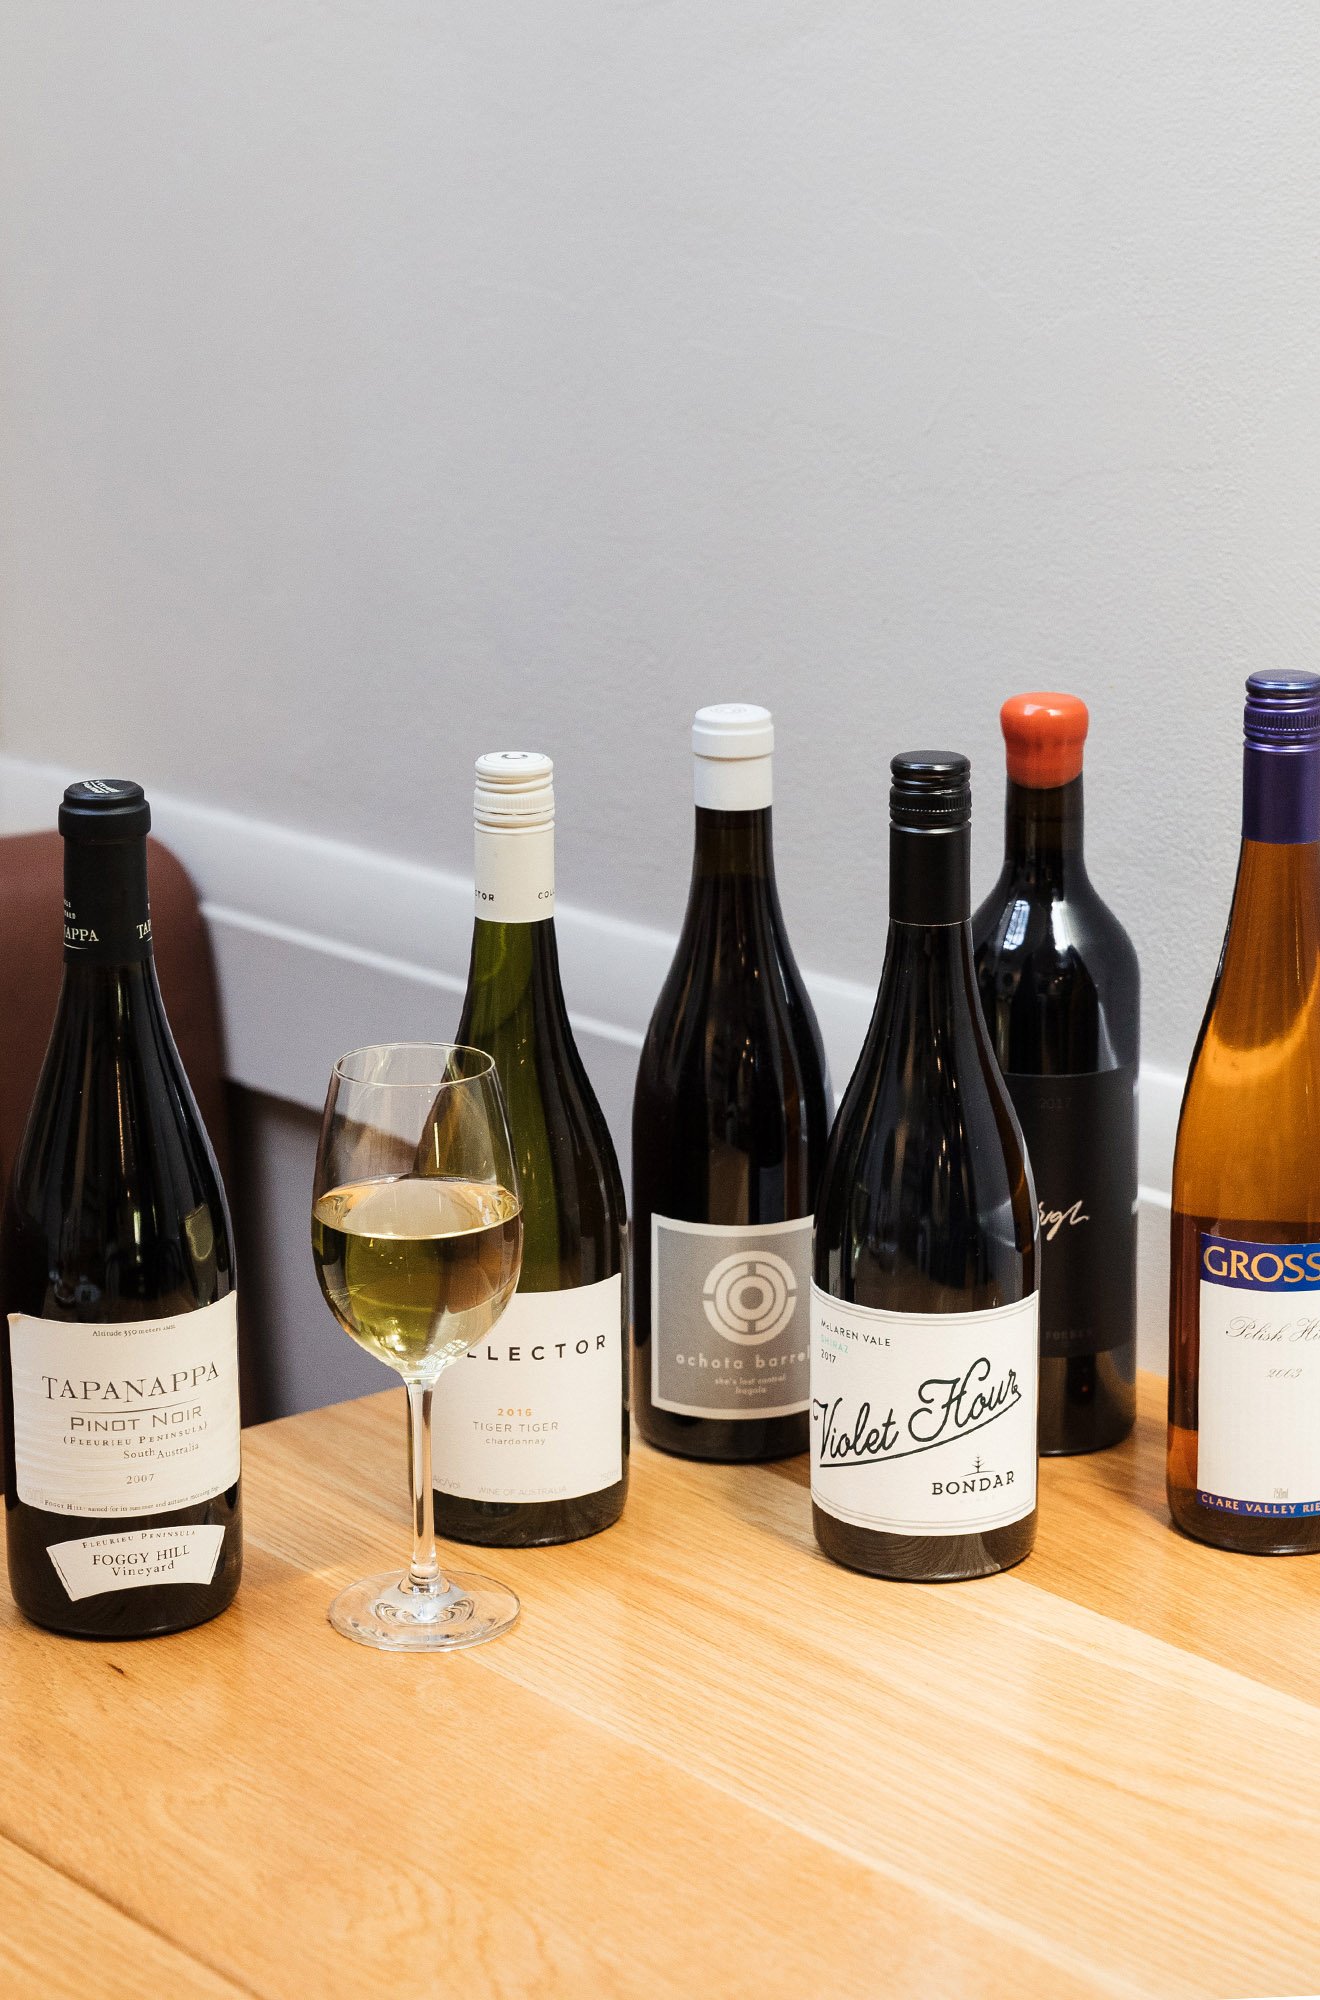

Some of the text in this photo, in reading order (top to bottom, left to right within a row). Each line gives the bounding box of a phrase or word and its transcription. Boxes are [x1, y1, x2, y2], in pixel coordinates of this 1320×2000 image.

[64, 925, 99, 942] APPA
[1203, 1245, 1320, 1283] GROSS
[1226, 1315, 1292, 1342] Polish
[820, 1334, 849, 1354] SHIRAZ
[862, 1333, 892, 1347] VALE
[820, 1348, 837, 1364] 2017
[42, 1361, 220, 1403] TAPANAPPA
[812, 1356, 1023, 1460] Violet Hour
[70, 1405, 202, 1432] PINOT NOIR
[472, 1421, 559, 1433] TIGER TIGER
[123, 1442, 200, 1460] South Australia
[485, 1437, 546, 1447] chardonnay
[126, 1473, 156, 1486] 2007
[931, 1470, 1016, 1496] BONDAR
[1201, 1493, 1239, 1510] CLARE
[1246, 1503, 1296, 1514] VALLEY
[92, 1544, 190, 1566] FOGGY HILL
[112, 1560, 175, 1577] Vineyard
